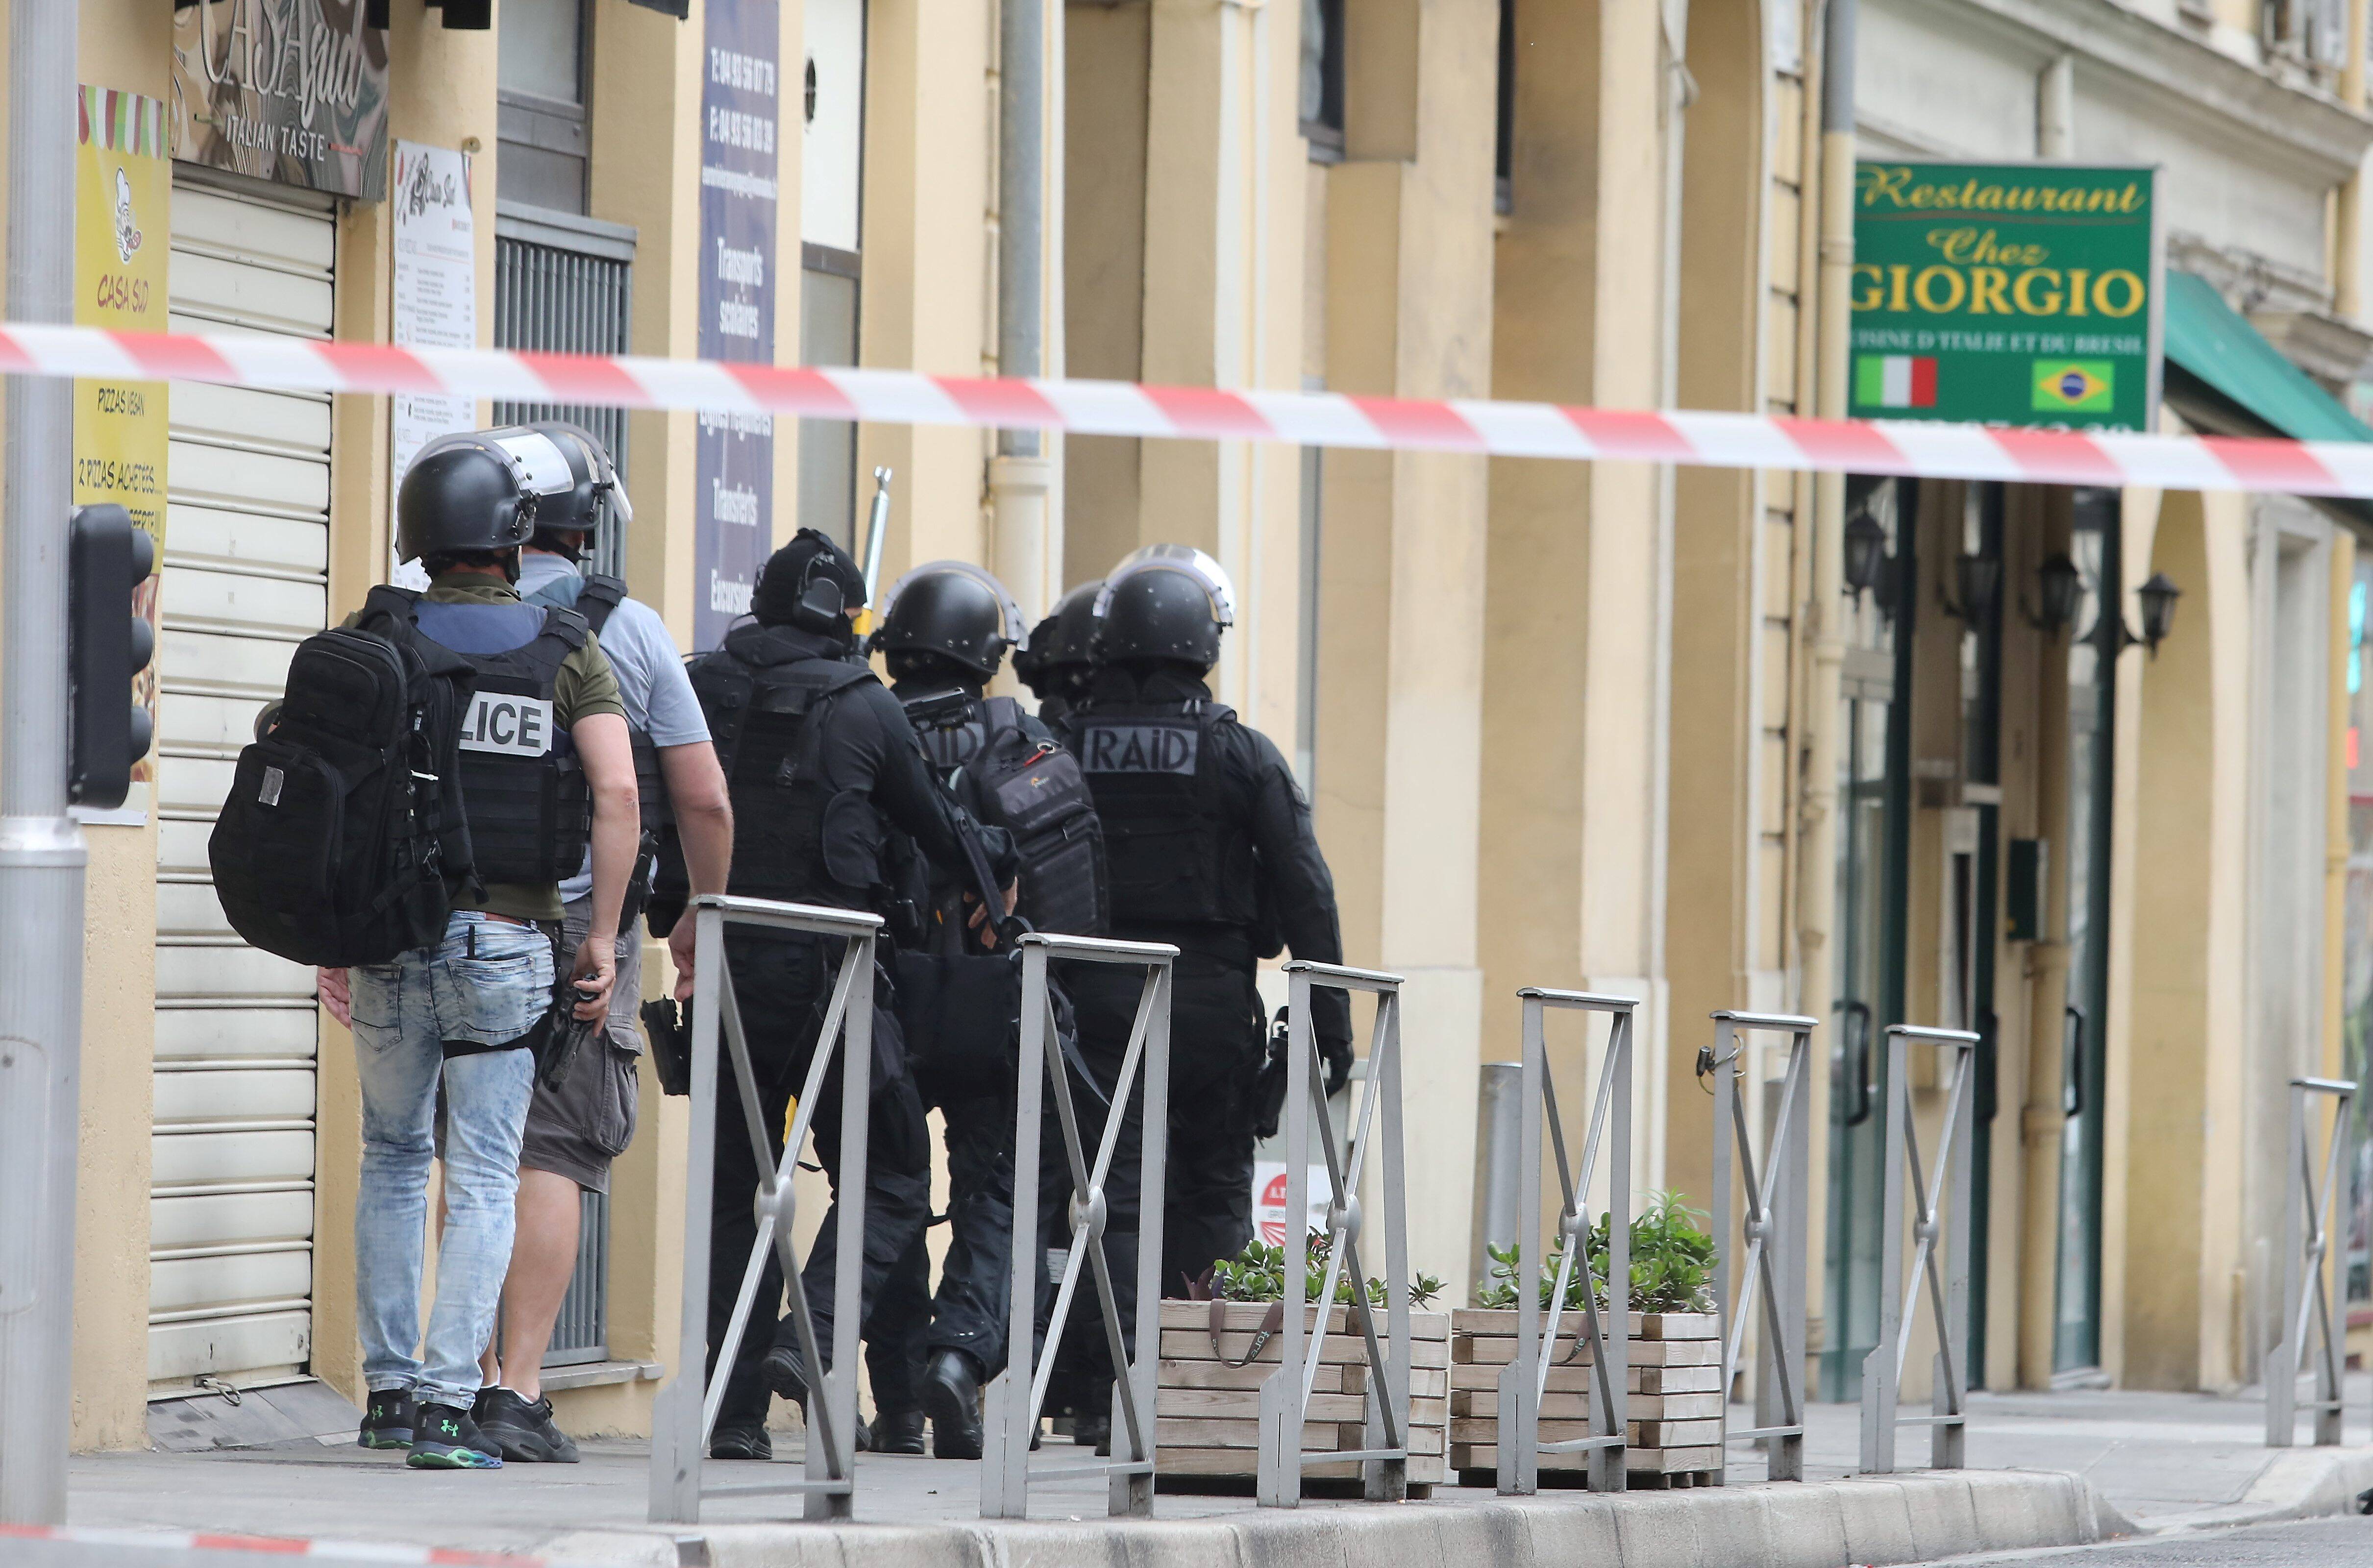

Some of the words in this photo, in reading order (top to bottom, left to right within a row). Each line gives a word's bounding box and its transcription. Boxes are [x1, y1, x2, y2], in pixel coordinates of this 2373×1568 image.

[226, 114, 274, 151] ITALIAN
[281, 126, 324, 162] TASTE
[1855, 164, 2147, 214] Restaurant
[1926, 226, 2052, 267] Chez
[98, 274, 129, 311] CASA
[132, 278, 149, 313] SUD
[1850, 263, 2146, 318] GIORGIO
[98, 387, 125, 415] PIZZAS
[78, 458, 85, 487] 2
[87, 459, 115, 490] PIZZAS
